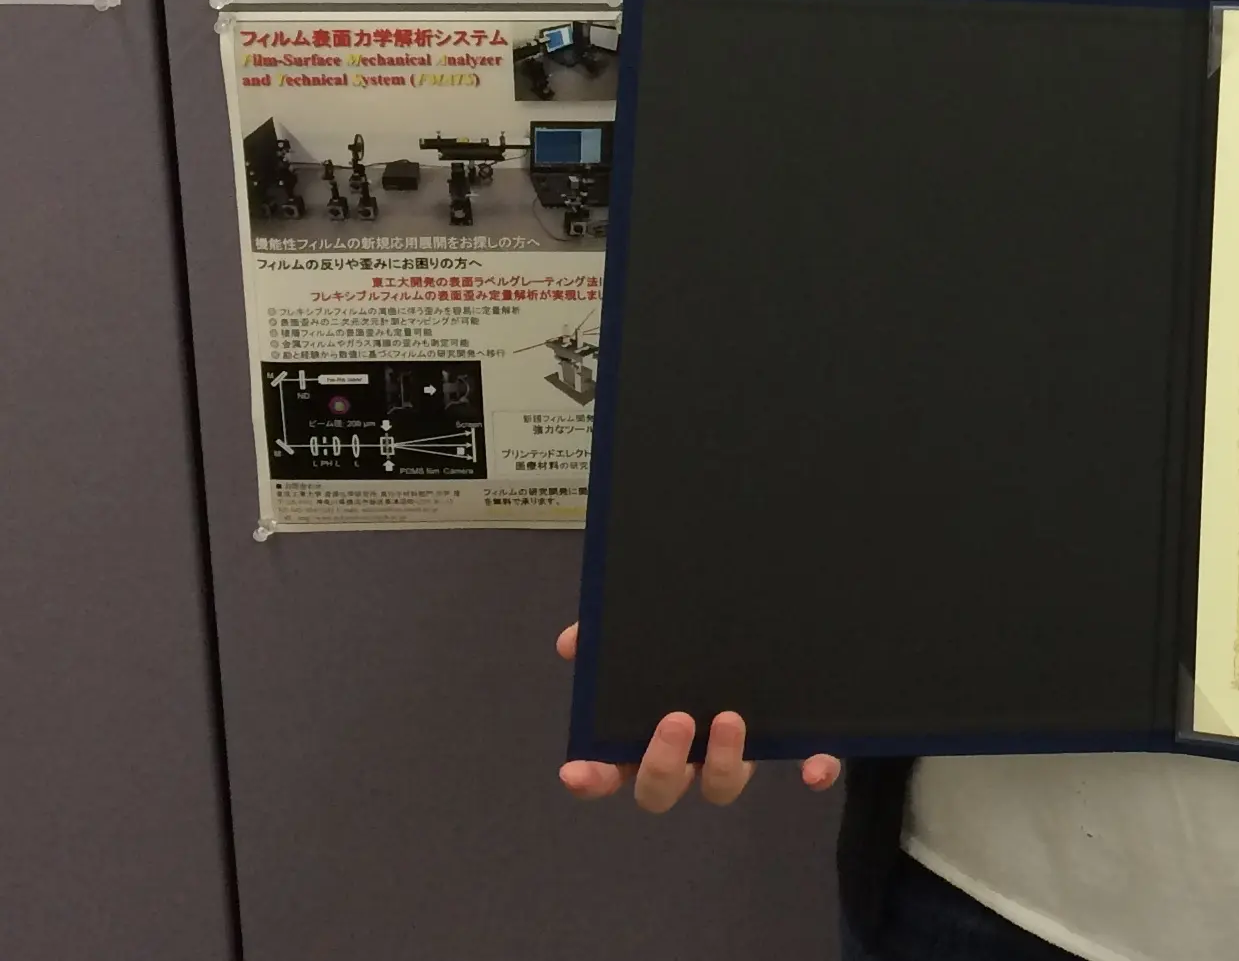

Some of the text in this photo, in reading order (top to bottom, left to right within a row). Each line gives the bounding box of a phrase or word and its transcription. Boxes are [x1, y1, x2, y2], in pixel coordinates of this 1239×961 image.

[240, 29, 508, 48] フィルム表面力学解析システム
[243, 54, 502, 69] Film-Surface Mechanical Analyzer
[243, 74, 271, 86] and
[277, 74, 348, 86] Technical
[352, 74, 406, 88] System
[255, 235, 540, 252] 機能性フィルムの新規応用展開をお探しの方へ
[257, 257, 483, 271] フィルムの反りや歪みにお困りの方へ
